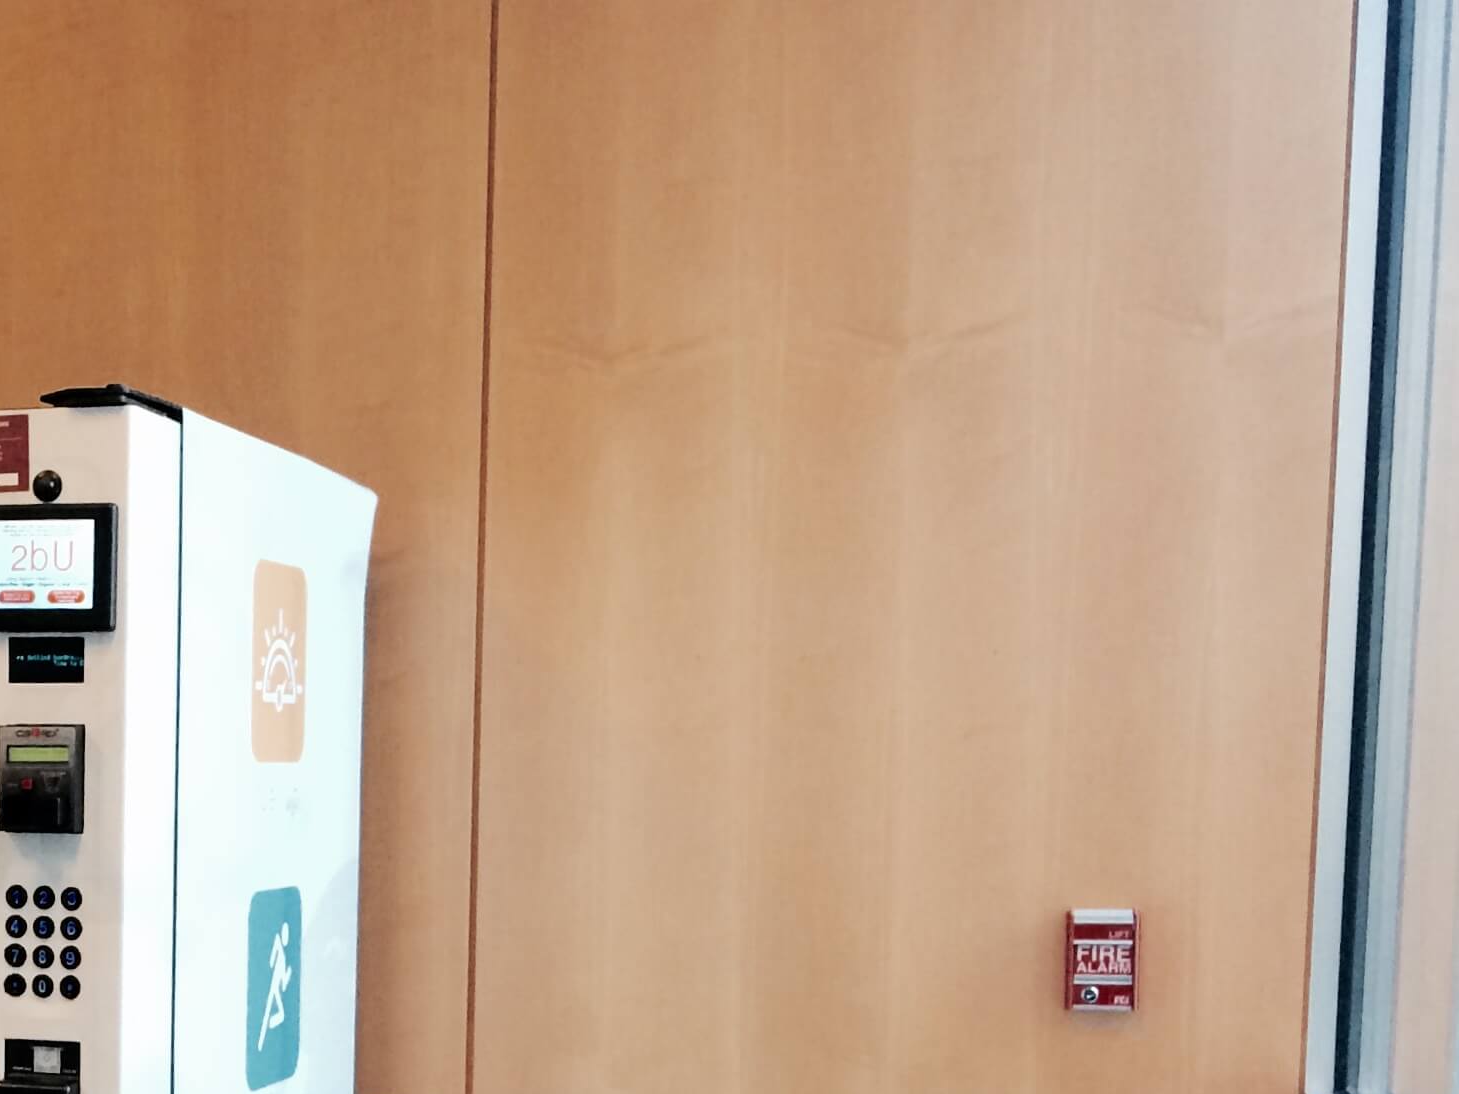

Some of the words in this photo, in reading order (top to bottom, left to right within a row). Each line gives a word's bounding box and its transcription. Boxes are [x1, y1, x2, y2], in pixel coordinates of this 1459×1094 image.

[11, 539, 74, 572] 2bU
[38, 890, 48, 905] 2
[67, 891, 77, 906] 3
[10, 919, 20, 934] 4
[38, 920, 48, 935] 5
[66, 920, 76, 936] 6
[11, 948, 20, 963] 7
[38, 949, 47, 965] 8
[65, 950, 75, 966] 9
[1076, 944, 1132, 962] FIRE
[1076, 961, 1132, 974] ALARM
[38, 979, 47, 993] 0
